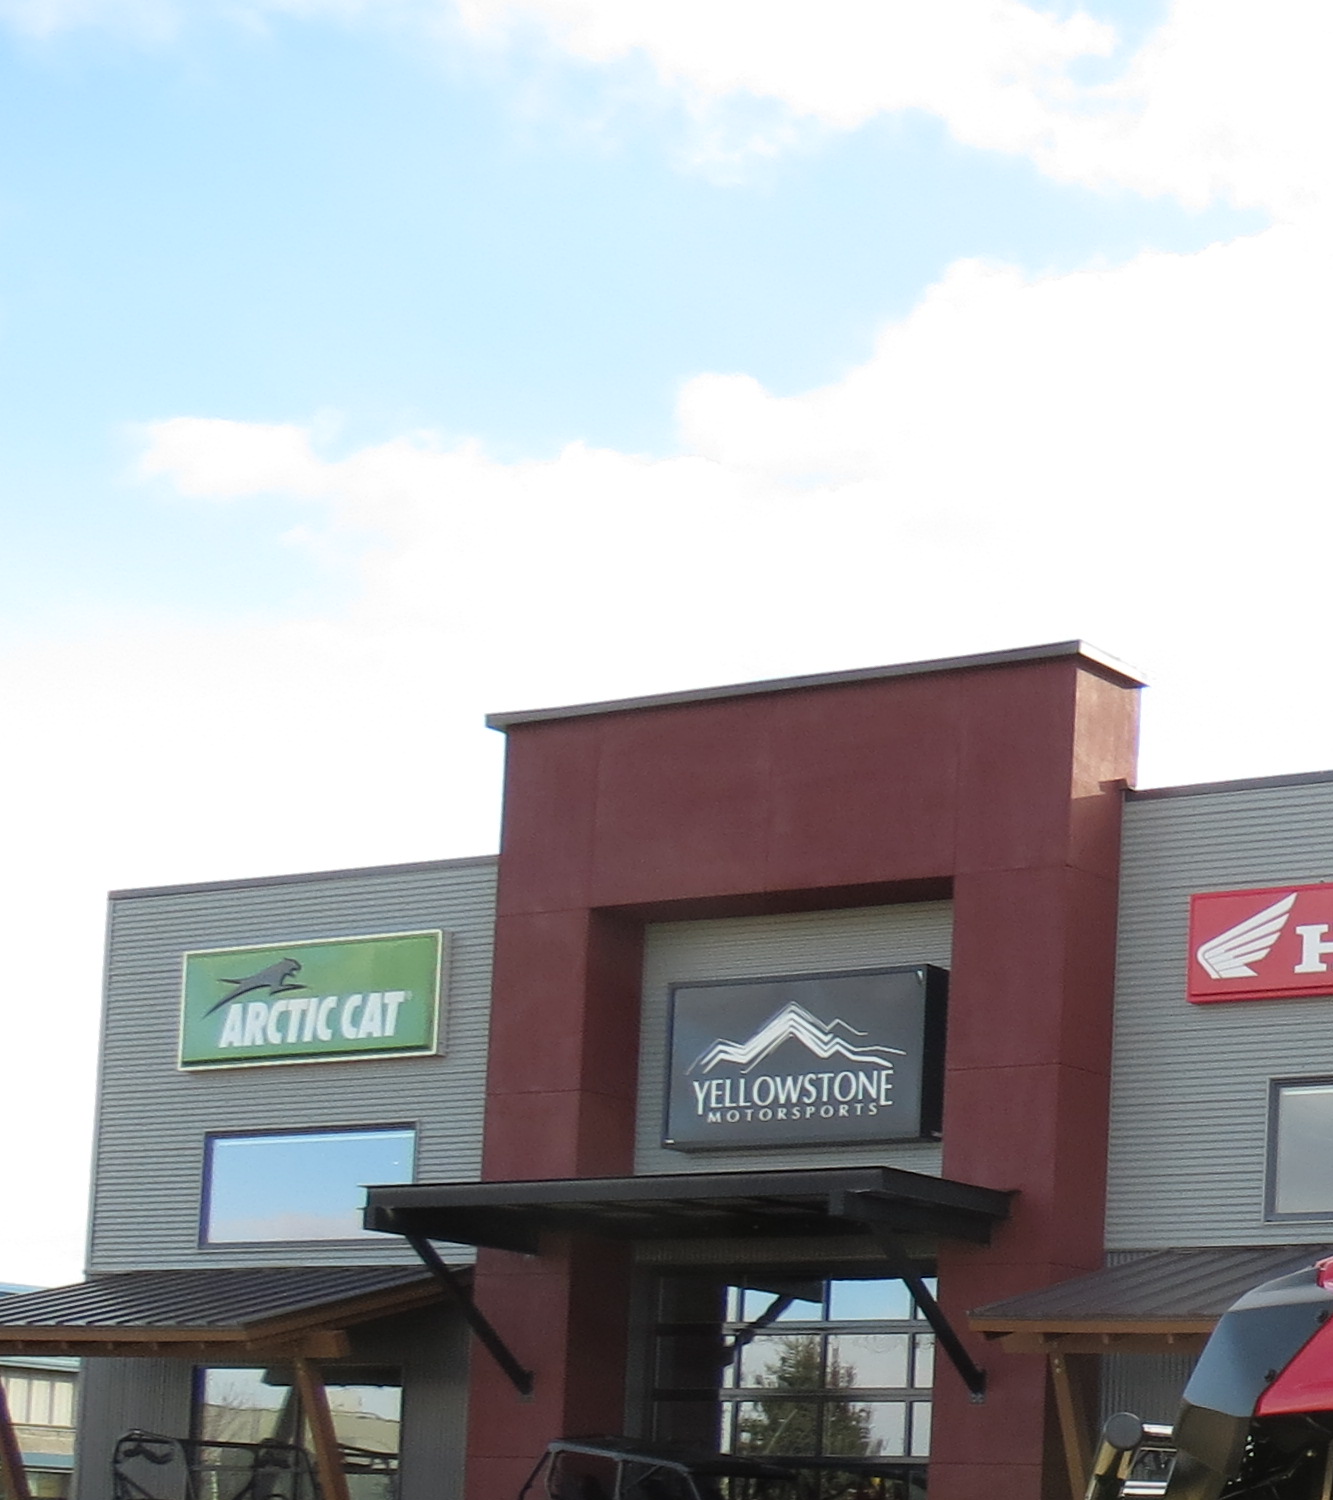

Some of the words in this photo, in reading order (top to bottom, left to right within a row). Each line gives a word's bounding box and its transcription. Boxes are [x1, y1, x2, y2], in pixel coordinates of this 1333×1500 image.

[218, 996, 338, 1048] ARCTIC
[341, 990, 405, 1039] CAT
[693, 1069, 894, 1115] YELLOWSTONE
[707, 1102, 878, 1123] MOTORSPORTS
